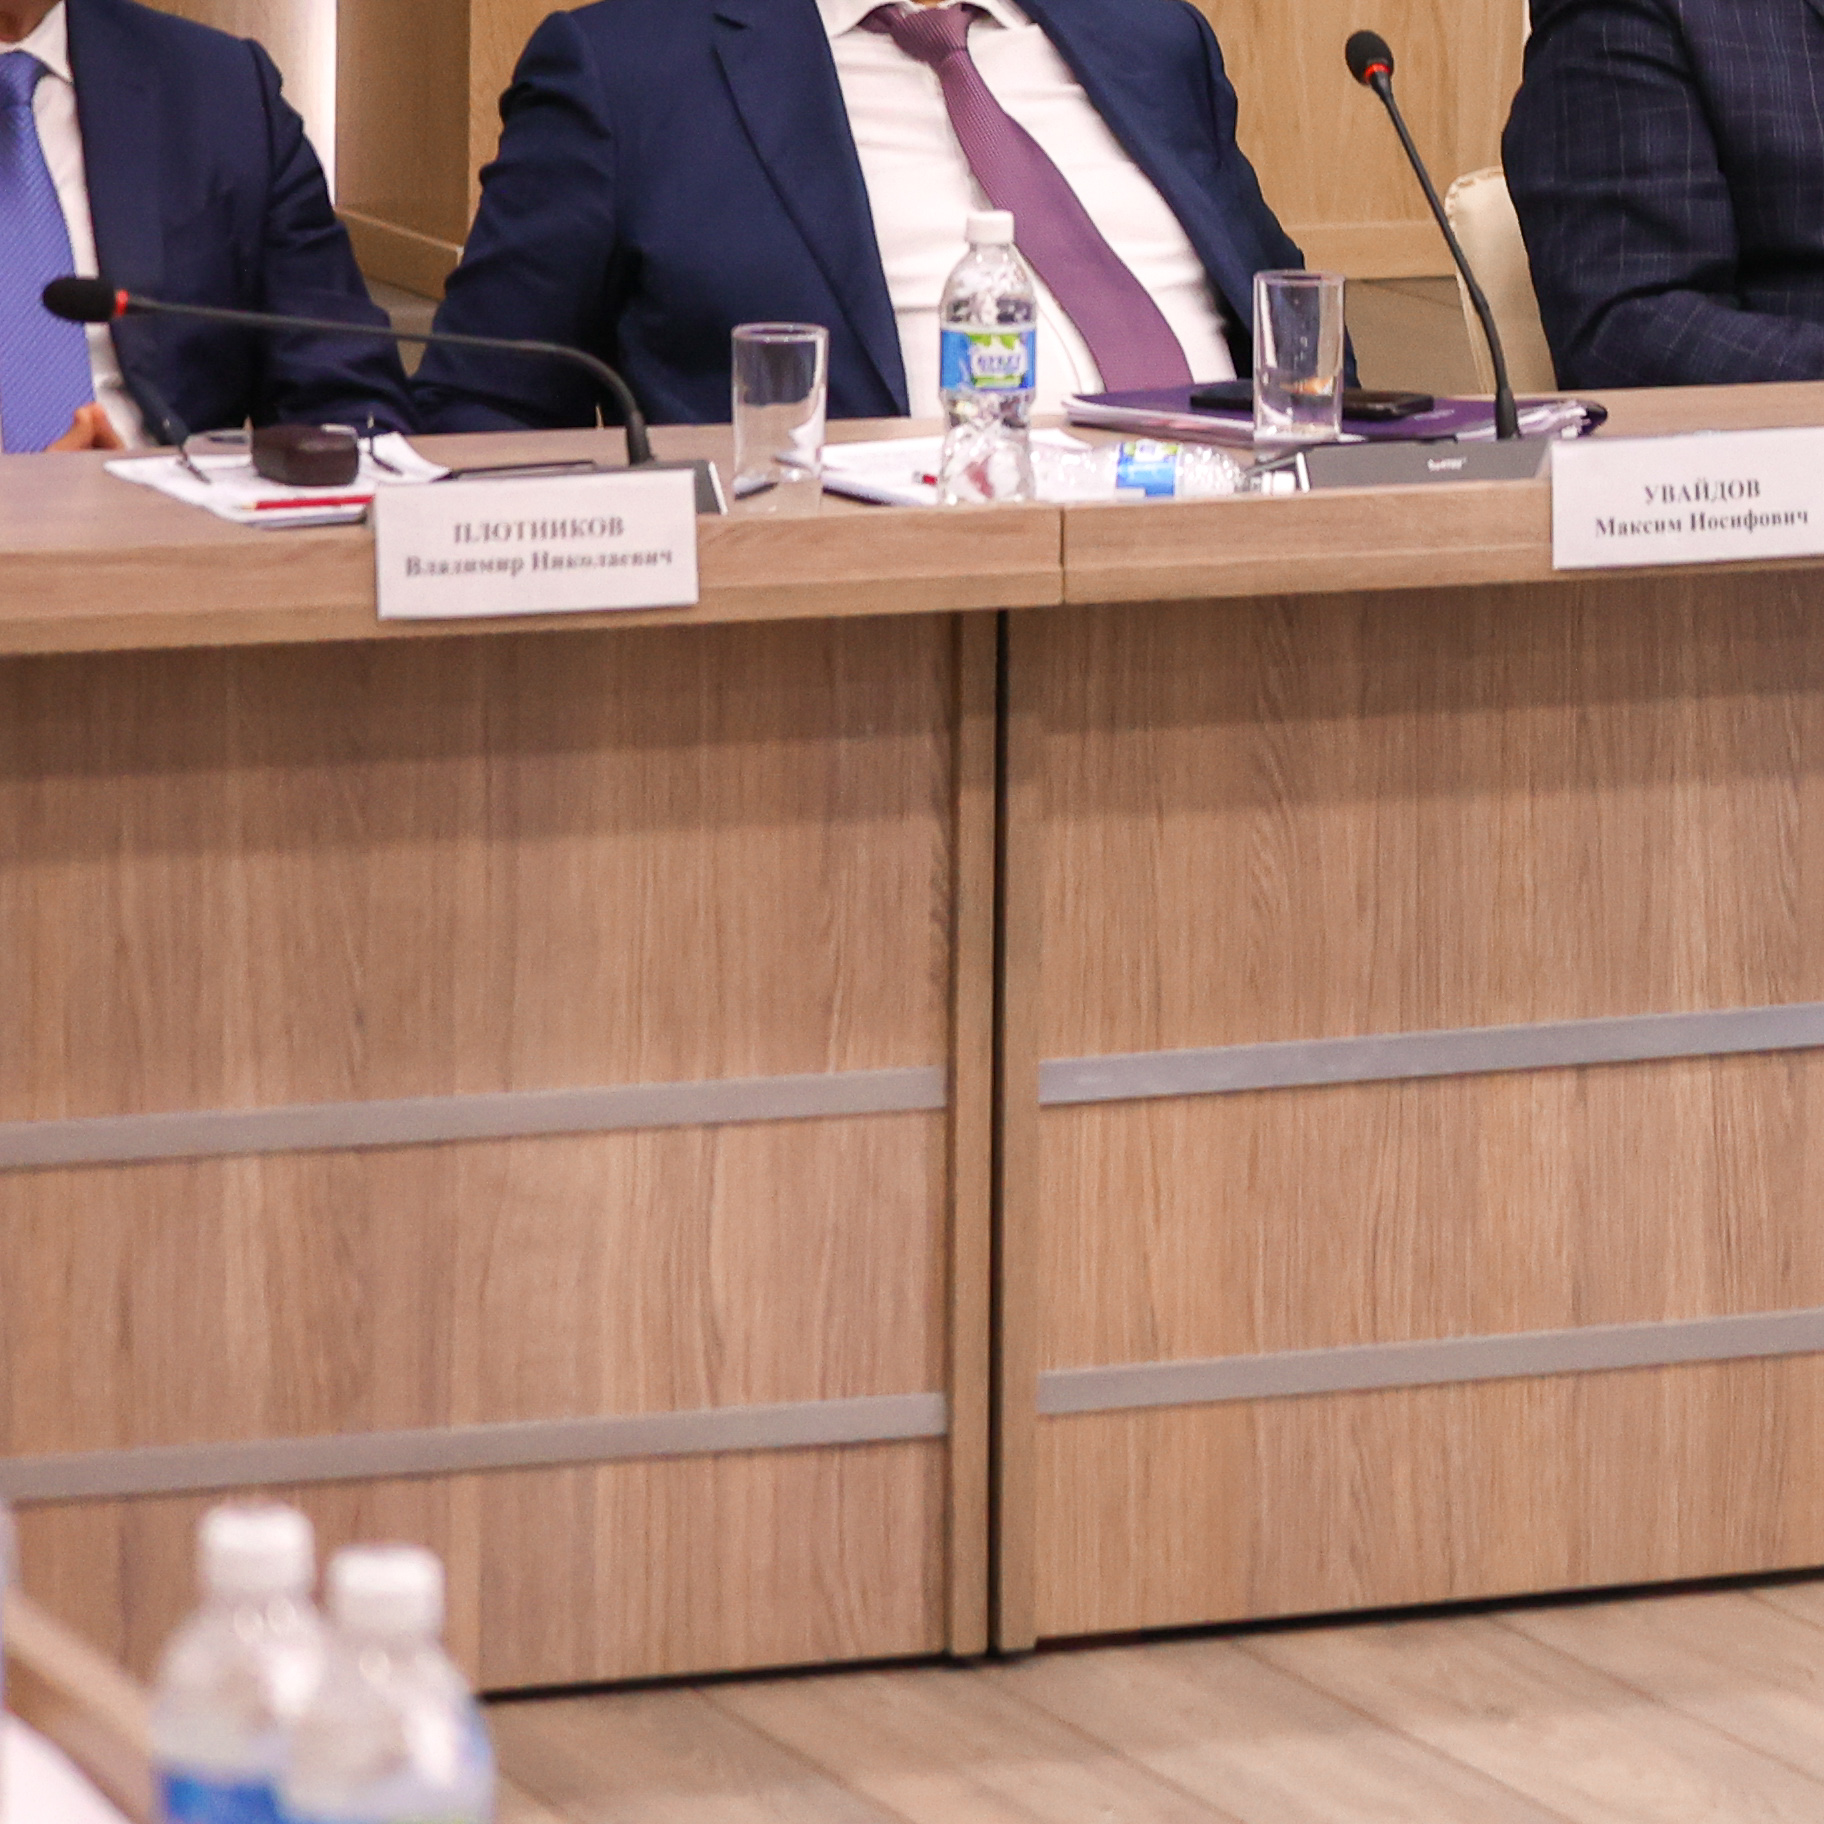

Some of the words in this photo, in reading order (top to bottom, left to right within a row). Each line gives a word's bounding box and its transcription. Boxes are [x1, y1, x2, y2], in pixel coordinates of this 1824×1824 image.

[1643, 478, 1762, 505] УВАЙДОВ
[453, 516, 625, 544] ПЛОТНИКОВ
[1595, 517, 1683, 538] Максим
[1690, 509, 1809, 534] Иосифович
[405, 554, 524, 578] Владимир
[531, 549, 673, 571] Николаевич
